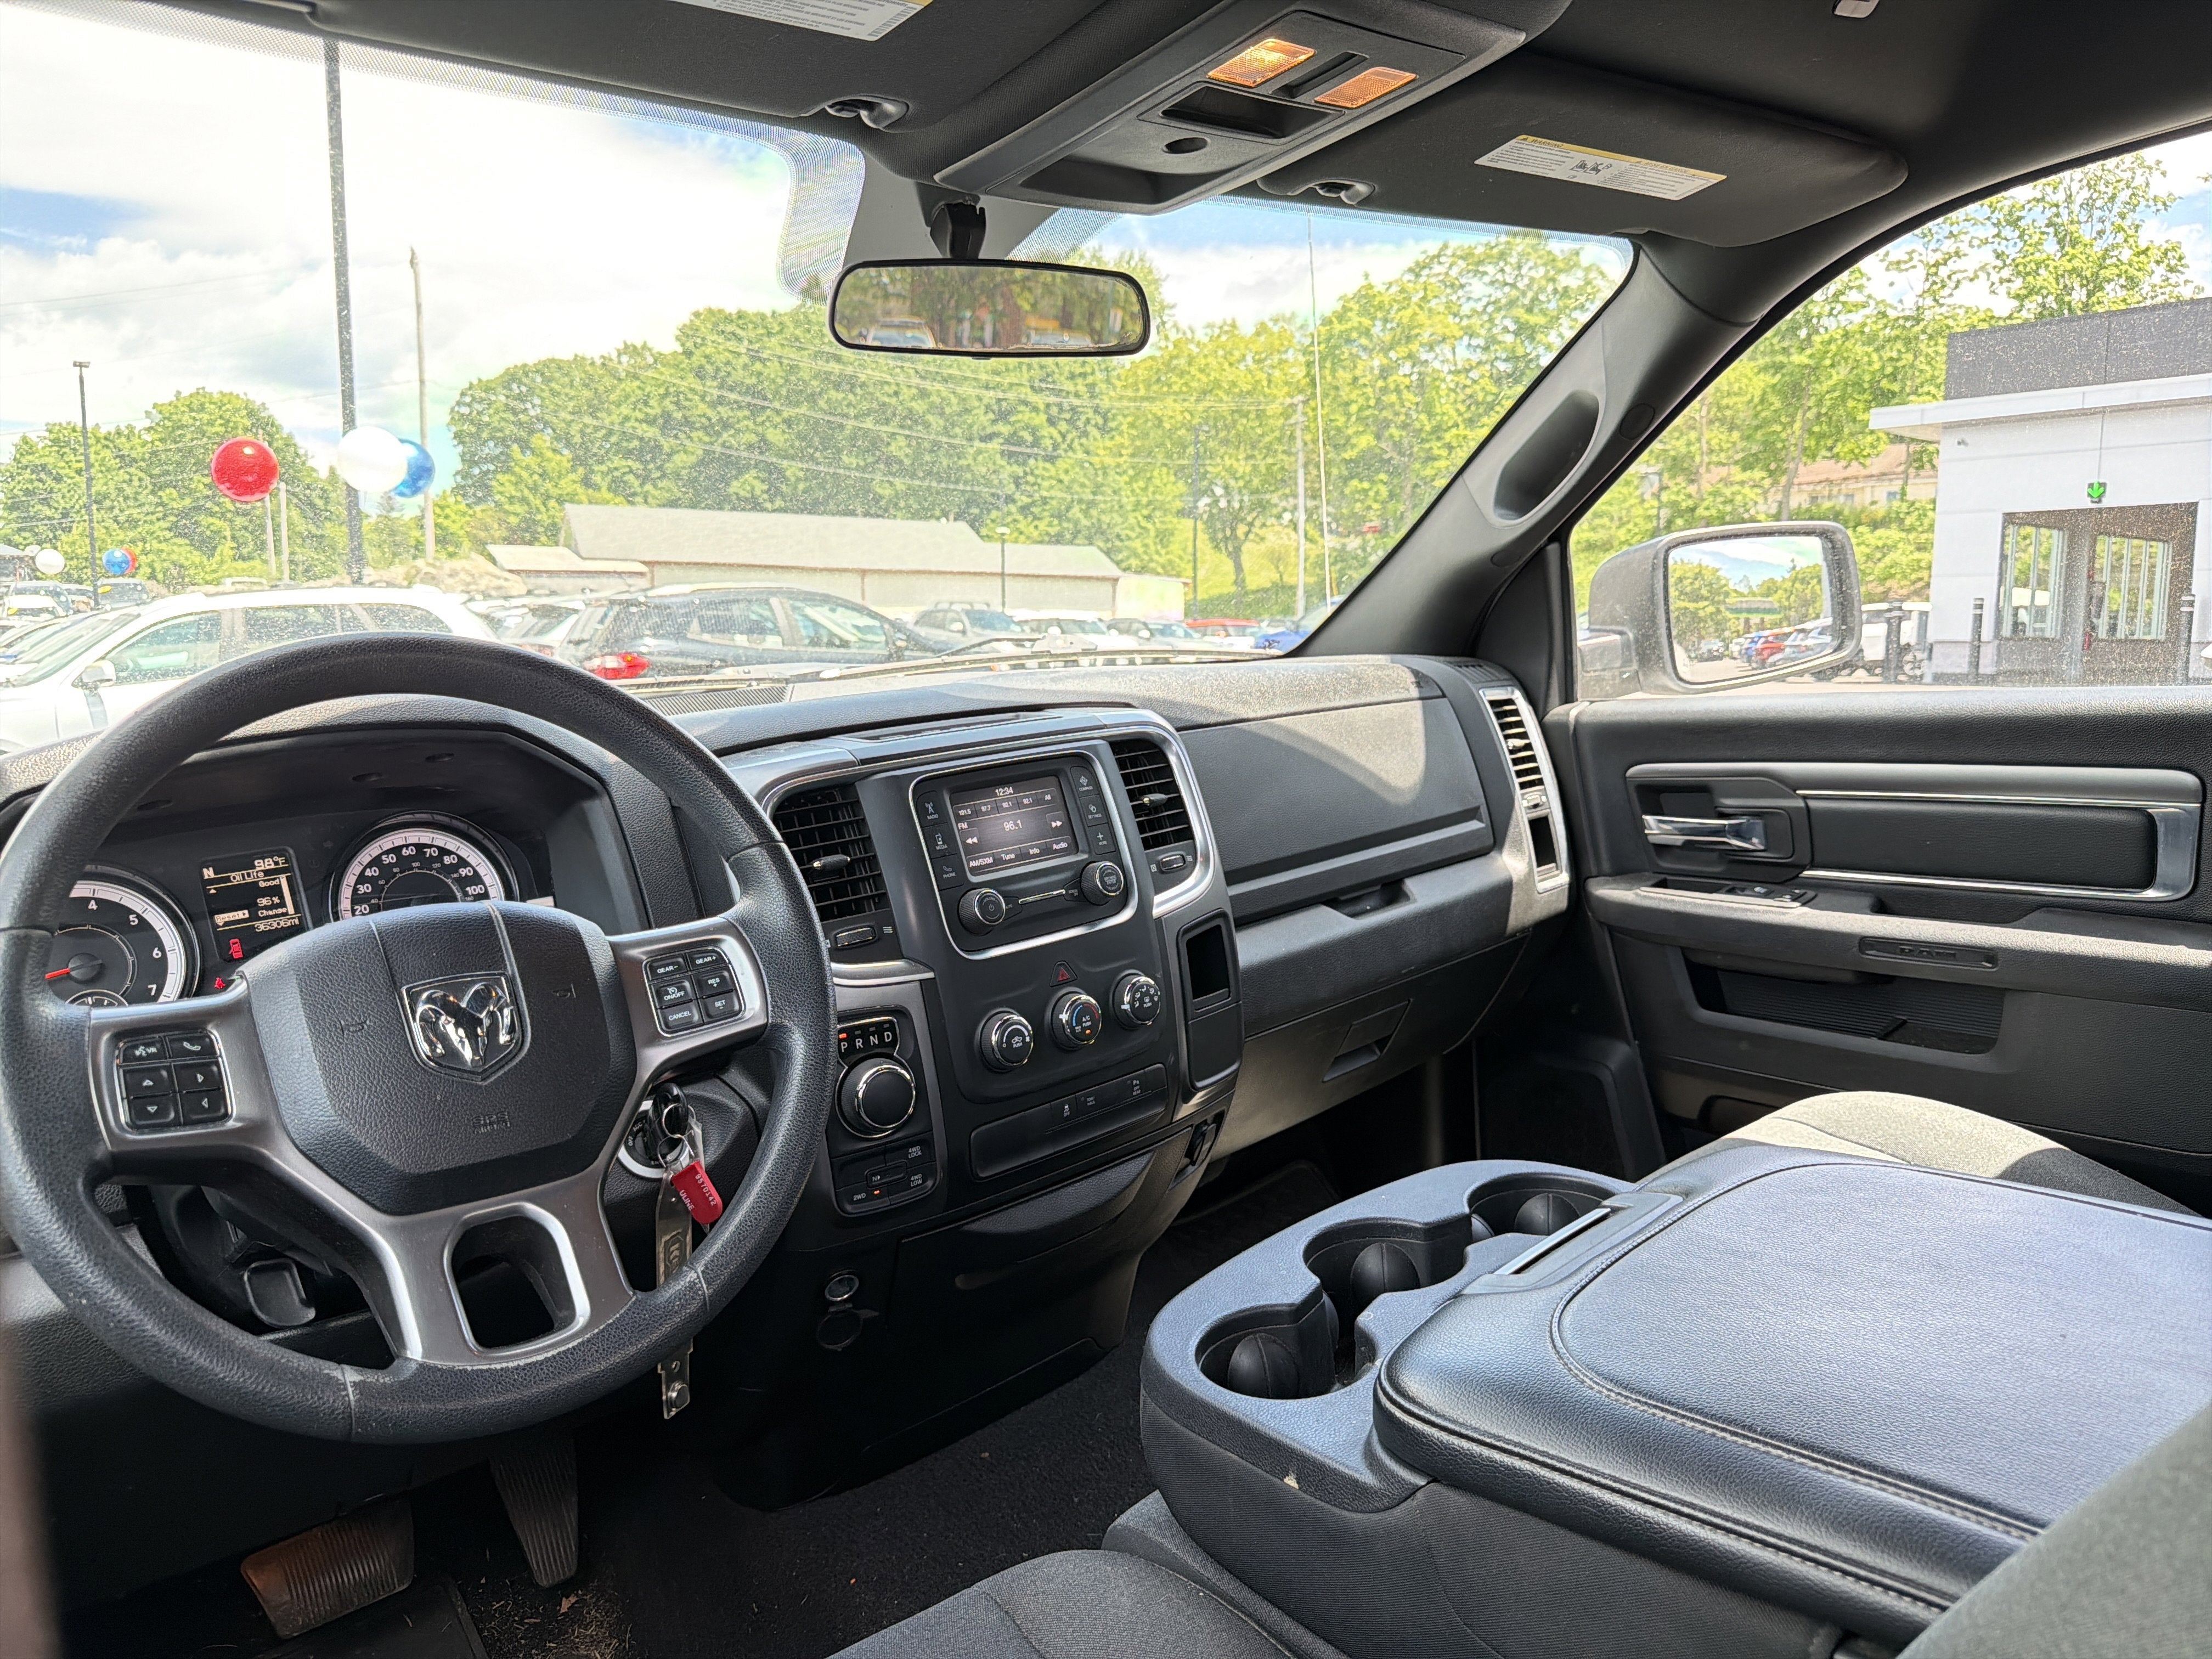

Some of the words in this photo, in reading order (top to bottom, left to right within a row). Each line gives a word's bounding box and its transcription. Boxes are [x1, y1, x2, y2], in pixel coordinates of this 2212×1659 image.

[1531, 139, 1564, 148] WARNING
[995, 786, 1014, 796] 12:34
[958, 822, 968, 830] FM
[1003, 819, 1023, 831] 96.1
[402, 846, 416, 856] 60
[424, 847, 438, 857] 70
[969, 857, 994, 868] AM/SXM
[1053, 842, 1068, 850] Audio
[382, 854, 397, 864] 50
[443, 855, 458, 865] 80
[202, 867, 215, 878] N
[254, 856, 286, 869] 98°F
[364, 867, 379, 877] 40
[459, 867, 473, 877] 90
[230, 873, 242, 882] Oil
[244, 871, 264, 880] Life
[259, 879, 280, 887] Good
[357, 883, 371, 894] 30
[466, 884, 485, 895] 100
[88, 900, 98, 910] 4
[354, 905, 369, 915] 20
[258, 907, 287, 917] Change
[129, 914, 139, 926] 5
[215, 913, 240, 922] Reset
[153, 947, 162, 958] 6
[147, 984, 157, 996] 7
[664, 991, 685, 1001] ON/OFF
[668, 1011, 692, 1021] CANCEL
[840, 1042, 848, 1053] P
[855, 1038, 864, 1049] R
[870, 1034, 878, 1046] N
[884, 1031, 892, 1042] D
[695, 1173, 717, 1206] 9570142
[679, 1189, 695, 1211] ULINE
